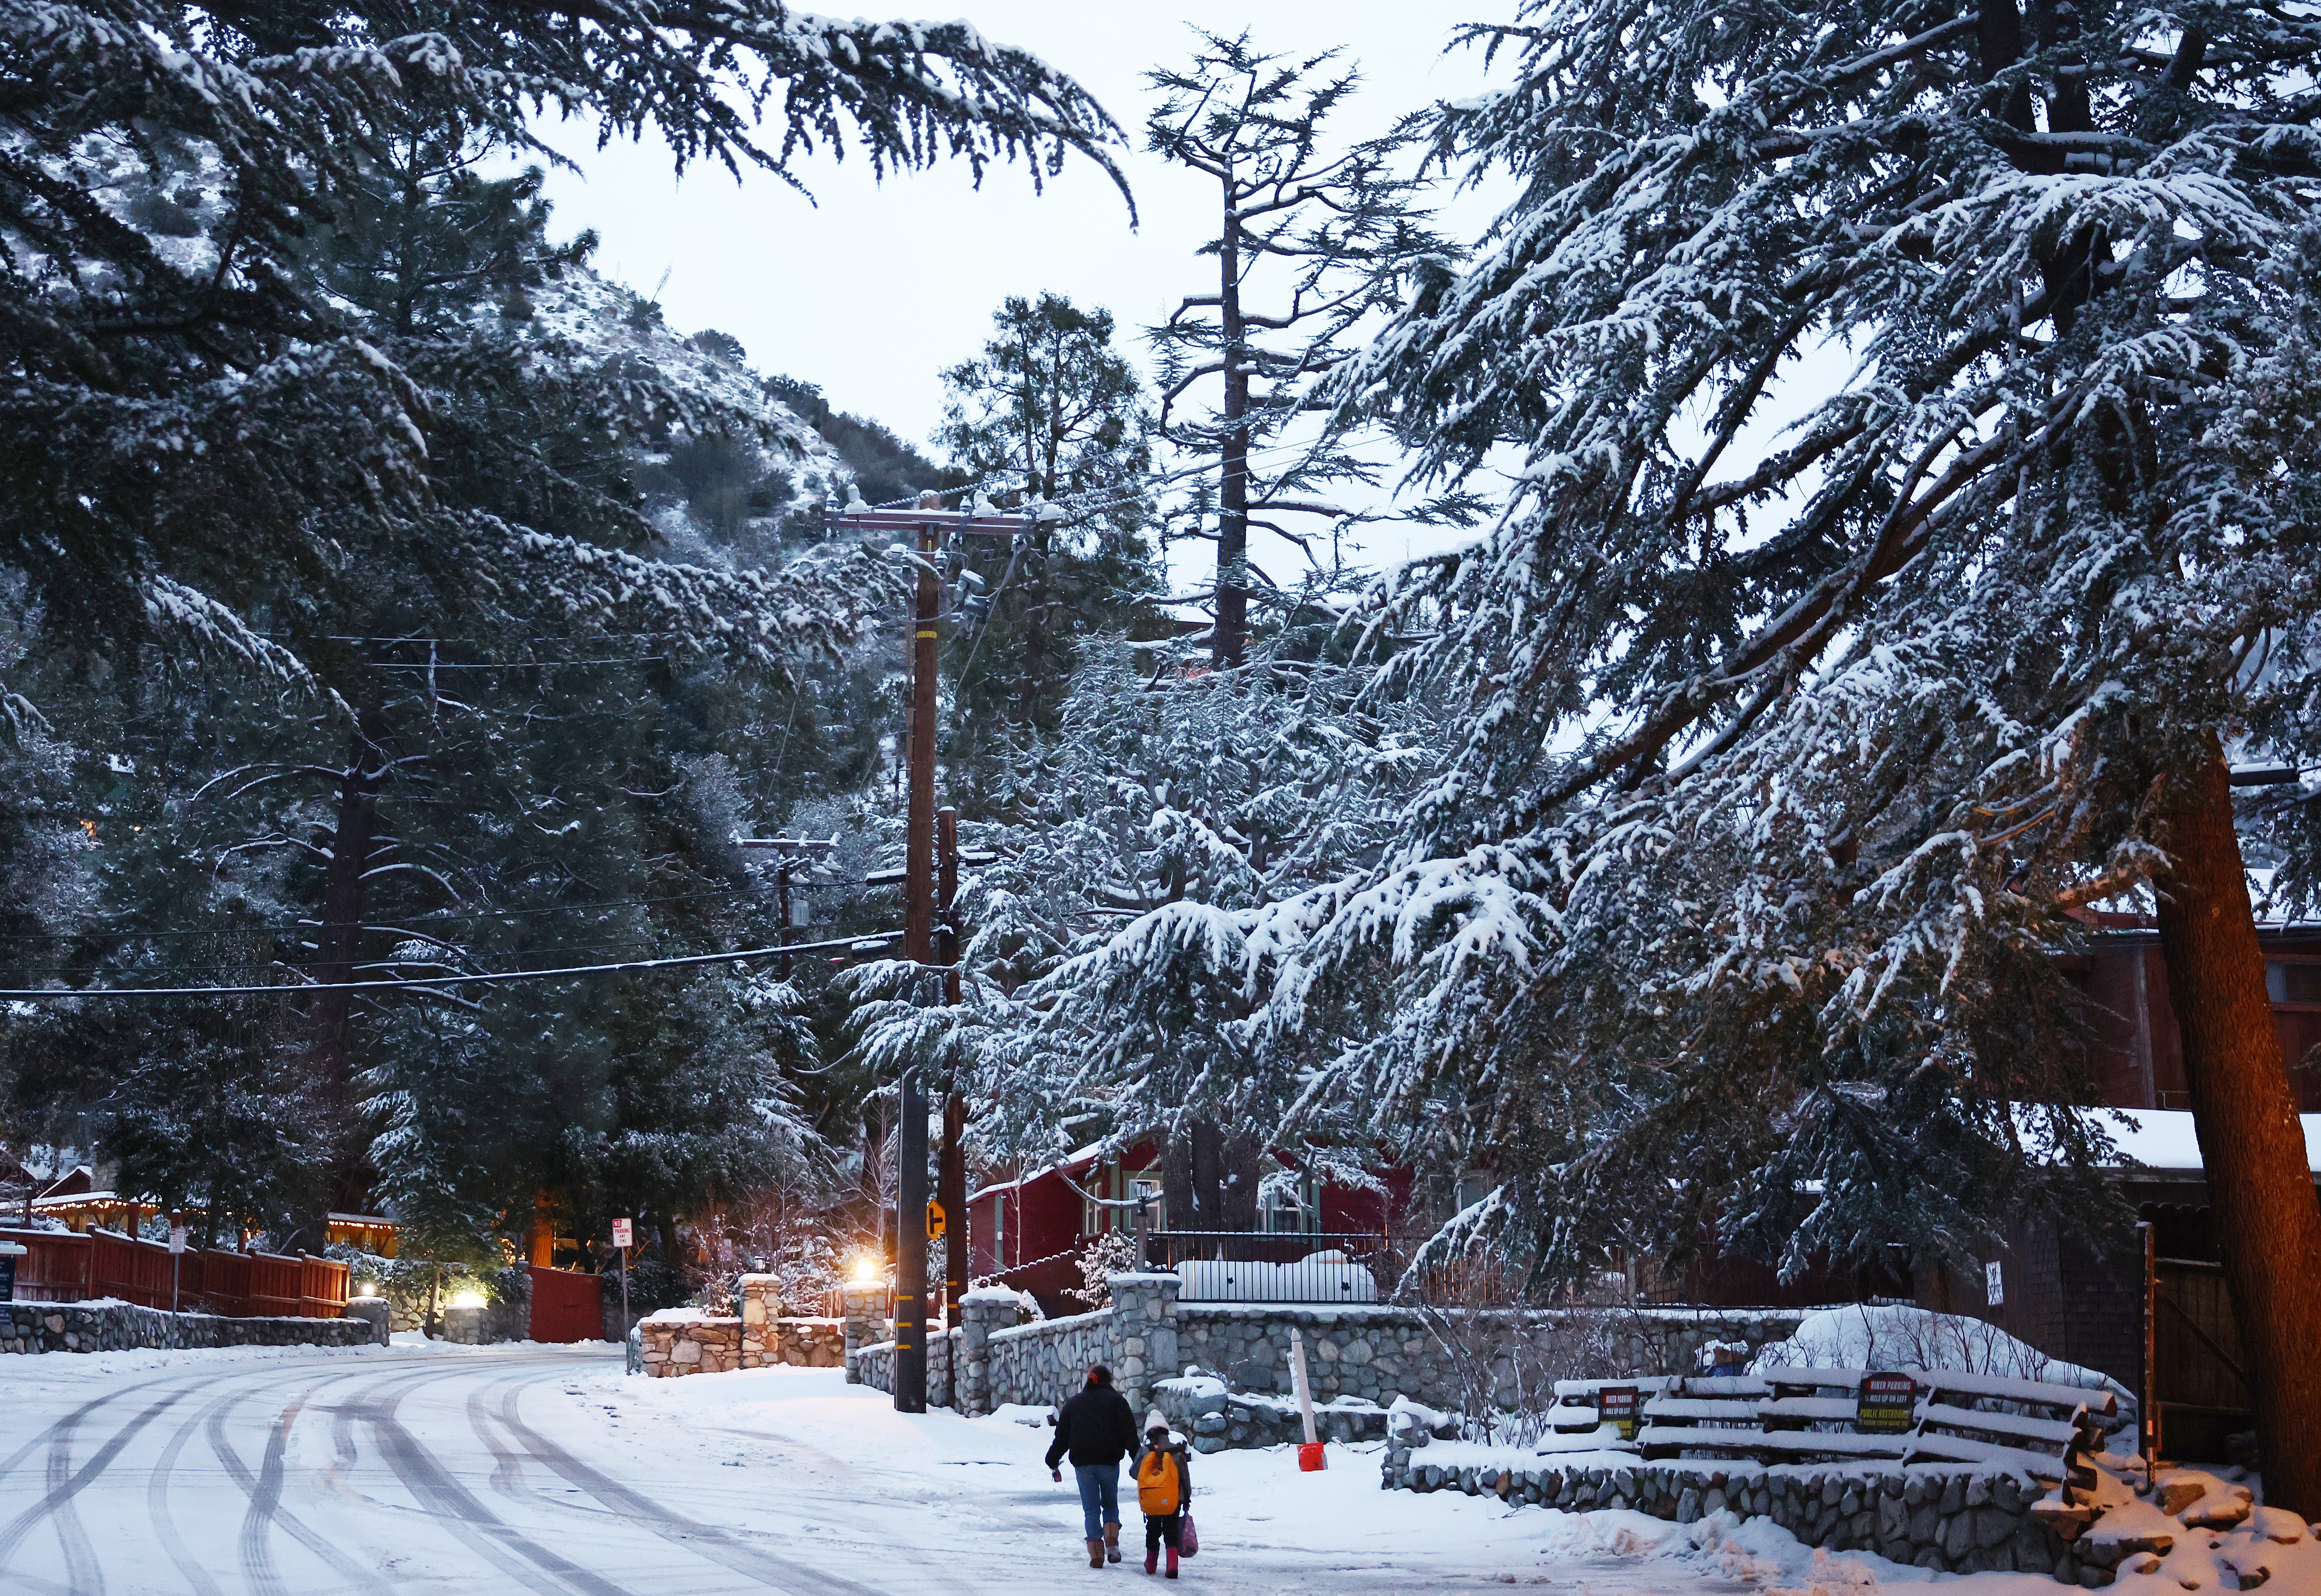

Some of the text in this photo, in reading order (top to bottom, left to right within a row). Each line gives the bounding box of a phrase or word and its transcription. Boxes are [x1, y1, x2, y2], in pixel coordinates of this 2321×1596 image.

[1871, 1381, 1911, 1390] HIKER PARKING
[1860, 1408, 1878, 1418] PUBLIC
